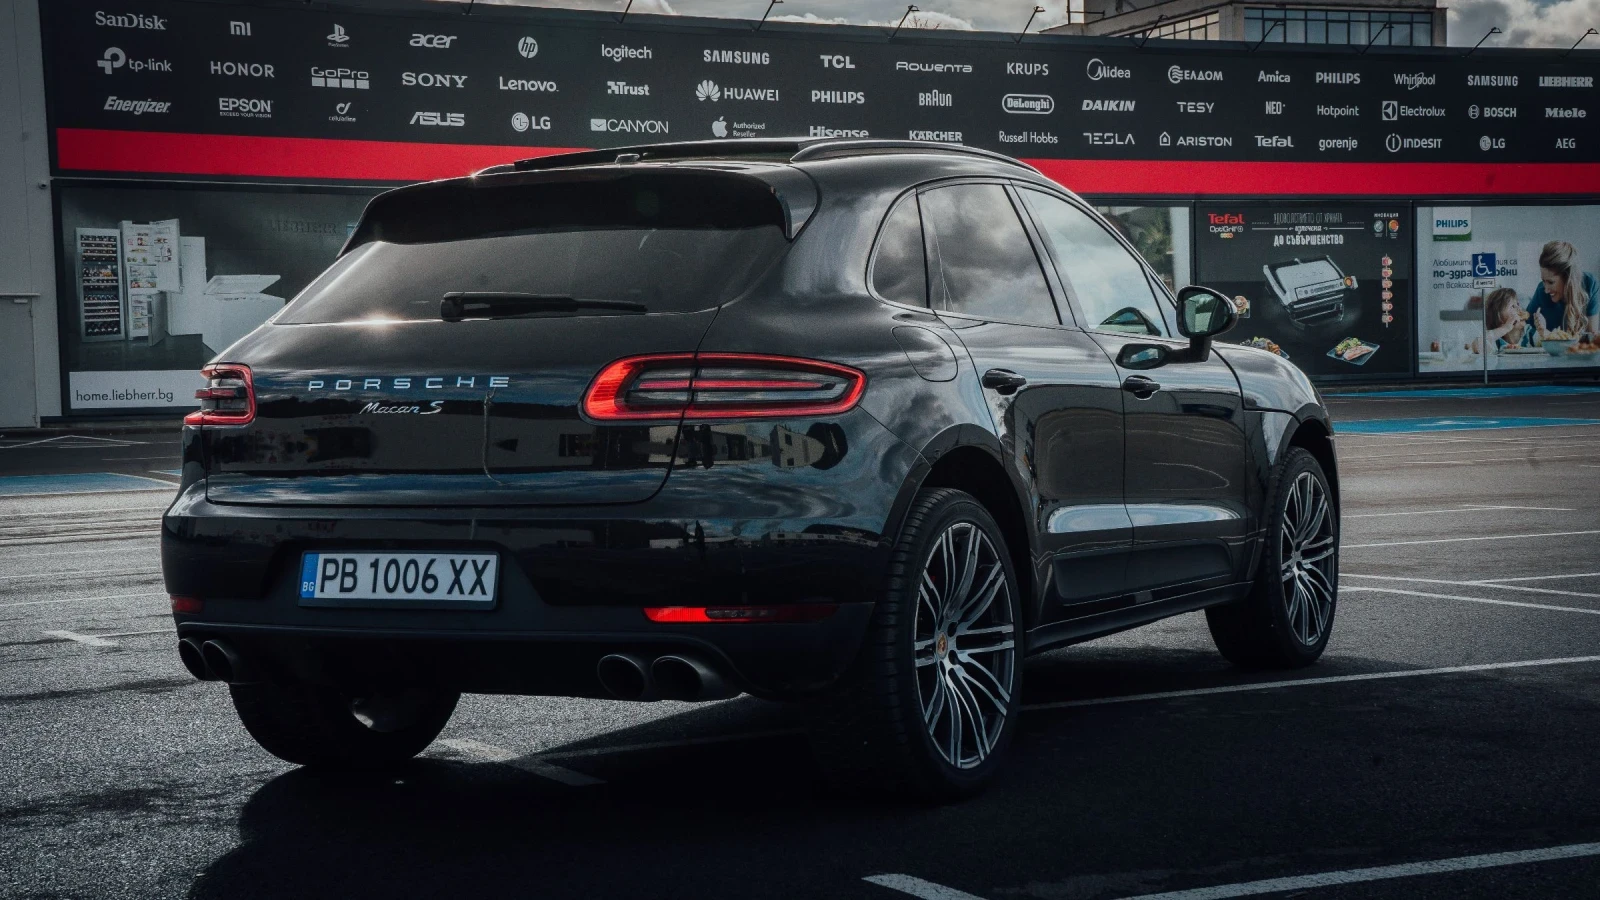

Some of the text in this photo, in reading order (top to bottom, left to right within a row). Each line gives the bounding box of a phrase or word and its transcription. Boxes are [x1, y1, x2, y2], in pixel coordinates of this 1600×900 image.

[96, 11, 167, 30] SanDisk
[410, 34, 457, 48] acer
[519, 37, 538, 58] hp
[602, 44, 652, 62] logitech
[704, 50, 769, 64] SAMSUNG
[128, 58, 173, 73] tp-link
[820, 55, 855, 68] TCL
[896, 62, 972, 72] Rowenta
[211, 61, 274, 77] HONOR
[311, 67, 369, 79] GoPro
[1007, 63, 1048, 75] KRUPS
[1098, 60, 1130, 79] Midea
[402, 72, 467, 88] SONY
[1258, 71, 1290, 82] Amica
[1316, 72, 1360, 84] PHILIPS
[1394, 72, 1435, 90] Whirlpool
[1468, 75, 1518, 86] SAMSUNG
[1539, 76, 1593, 87] LIEBHERR
[500, 76, 559, 91] Lenovo
[618, 81, 650, 96] Trust
[724, 88, 778, 101] HUAWEI
[812, 90, 865, 104] PHILIPS
[919, 90, 952, 106] BRAUN
[104, 96, 171, 115] Energizer
[219, 97, 271, 113] EPSON
[1082, 100, 1135, 111] DAIKIN
[1177, 102, 1214, 113] TESY
[1317, 105, 1359, 118] Hotpoint
[1400, 104, 1447, 119] Electrolux
[1484, 107, 1516, 117] BOSCH
[1545, 108, 1586, 118] Miele
[410, 112, 465, 126] ASUS
[531, 116, 551, 130] LG
[608, 119, 669, 134] CANYON
[733, 121, 766, 131] Authorized
[809, 126, 870, 138] Hisense
[733, 130, 757, 138] Reseller
[908, 130, 963, 142] KÄRCHER
[998, 131, 1059, 144] Russell Hobbs
[1083, 133, 1135, 144] TESLA
[1177, 137, 1232, 146] ARISTON
[1255, 136, 1293, 147] Tefal
[1319, 137, 1357, 151] gorenje
[1492, 137, 1506, 150] LG
[1556, 138, 1575, 148] AEG
[1208, 213, 1245, 225] Tefal
[1436, 220, 1468, 228] PHILIPS
[1273, 236, 1285, 247] ДО
[307, 376, 510, 392] PORSCHE
[75, 388, 174, 404] home.liebherr.bg
[358, 402, 420, 415] Macan
[420, 400, 445, 416] S
[319, 557, 491, 596] PB 1006 XX
[302, 582, 314, 592] BG
